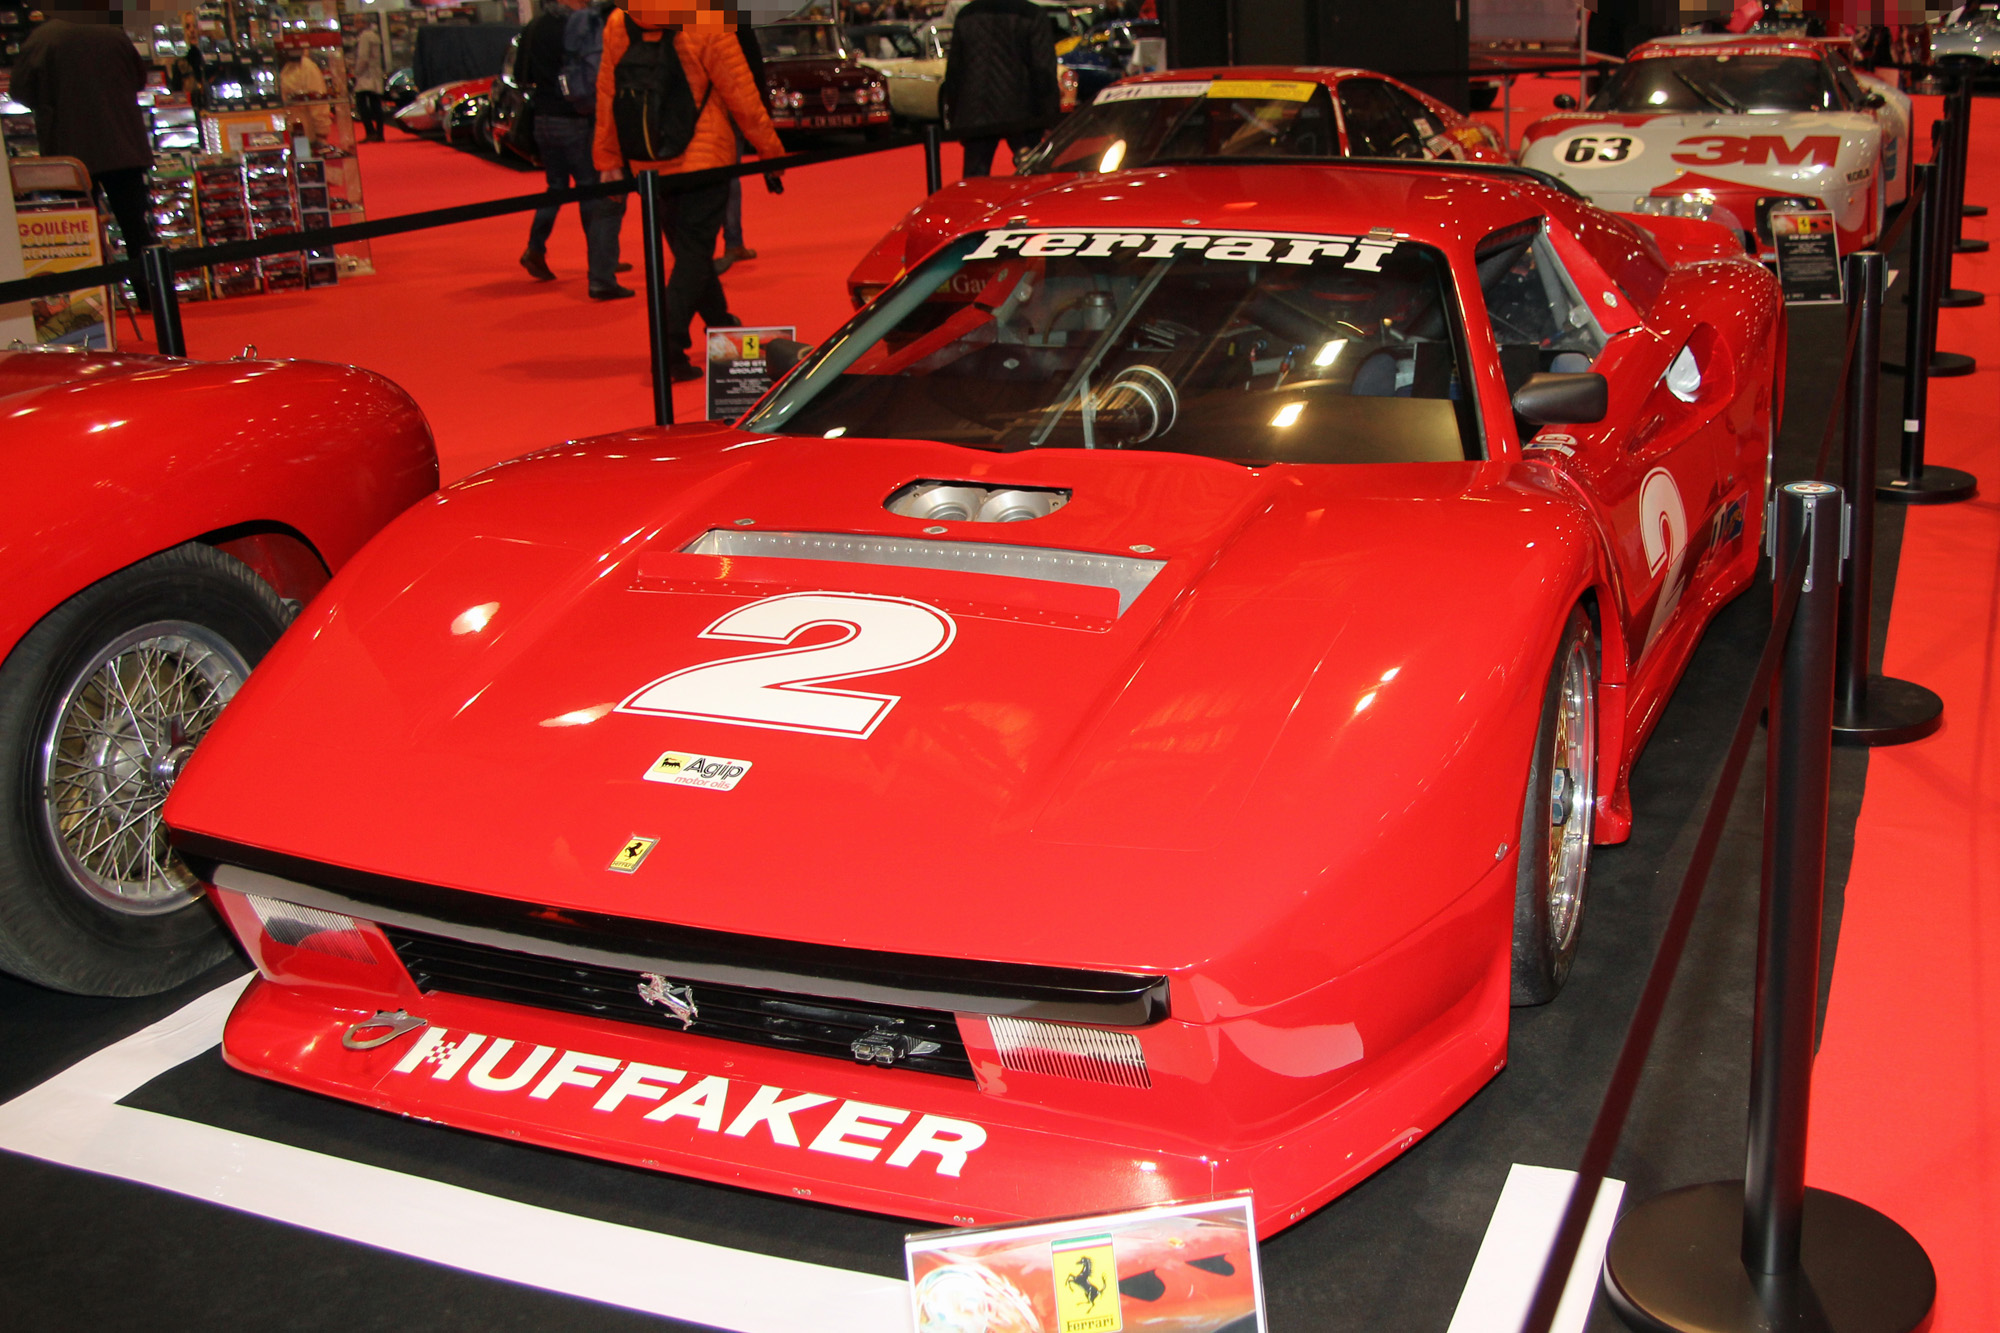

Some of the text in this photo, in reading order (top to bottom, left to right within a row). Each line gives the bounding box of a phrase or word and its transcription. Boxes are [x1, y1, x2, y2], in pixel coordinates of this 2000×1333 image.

[1563, 137, 1633, 164] 63
[1670, 135, 1842, 168] 3M
[19, 220, 89, 236] GOULÊME
[962, 228, 1398, 273] Ferrari
[1638, 466, 1689, 657] 2
[612, 590, 958, 741] 2
[674, 776, 731, 790] motor oils
[683, 757, 744, 780] Agip
[394, 1025, 989, 1178] HUFFAKER
[1066, 1314, 1114, 1332] Ferrari
